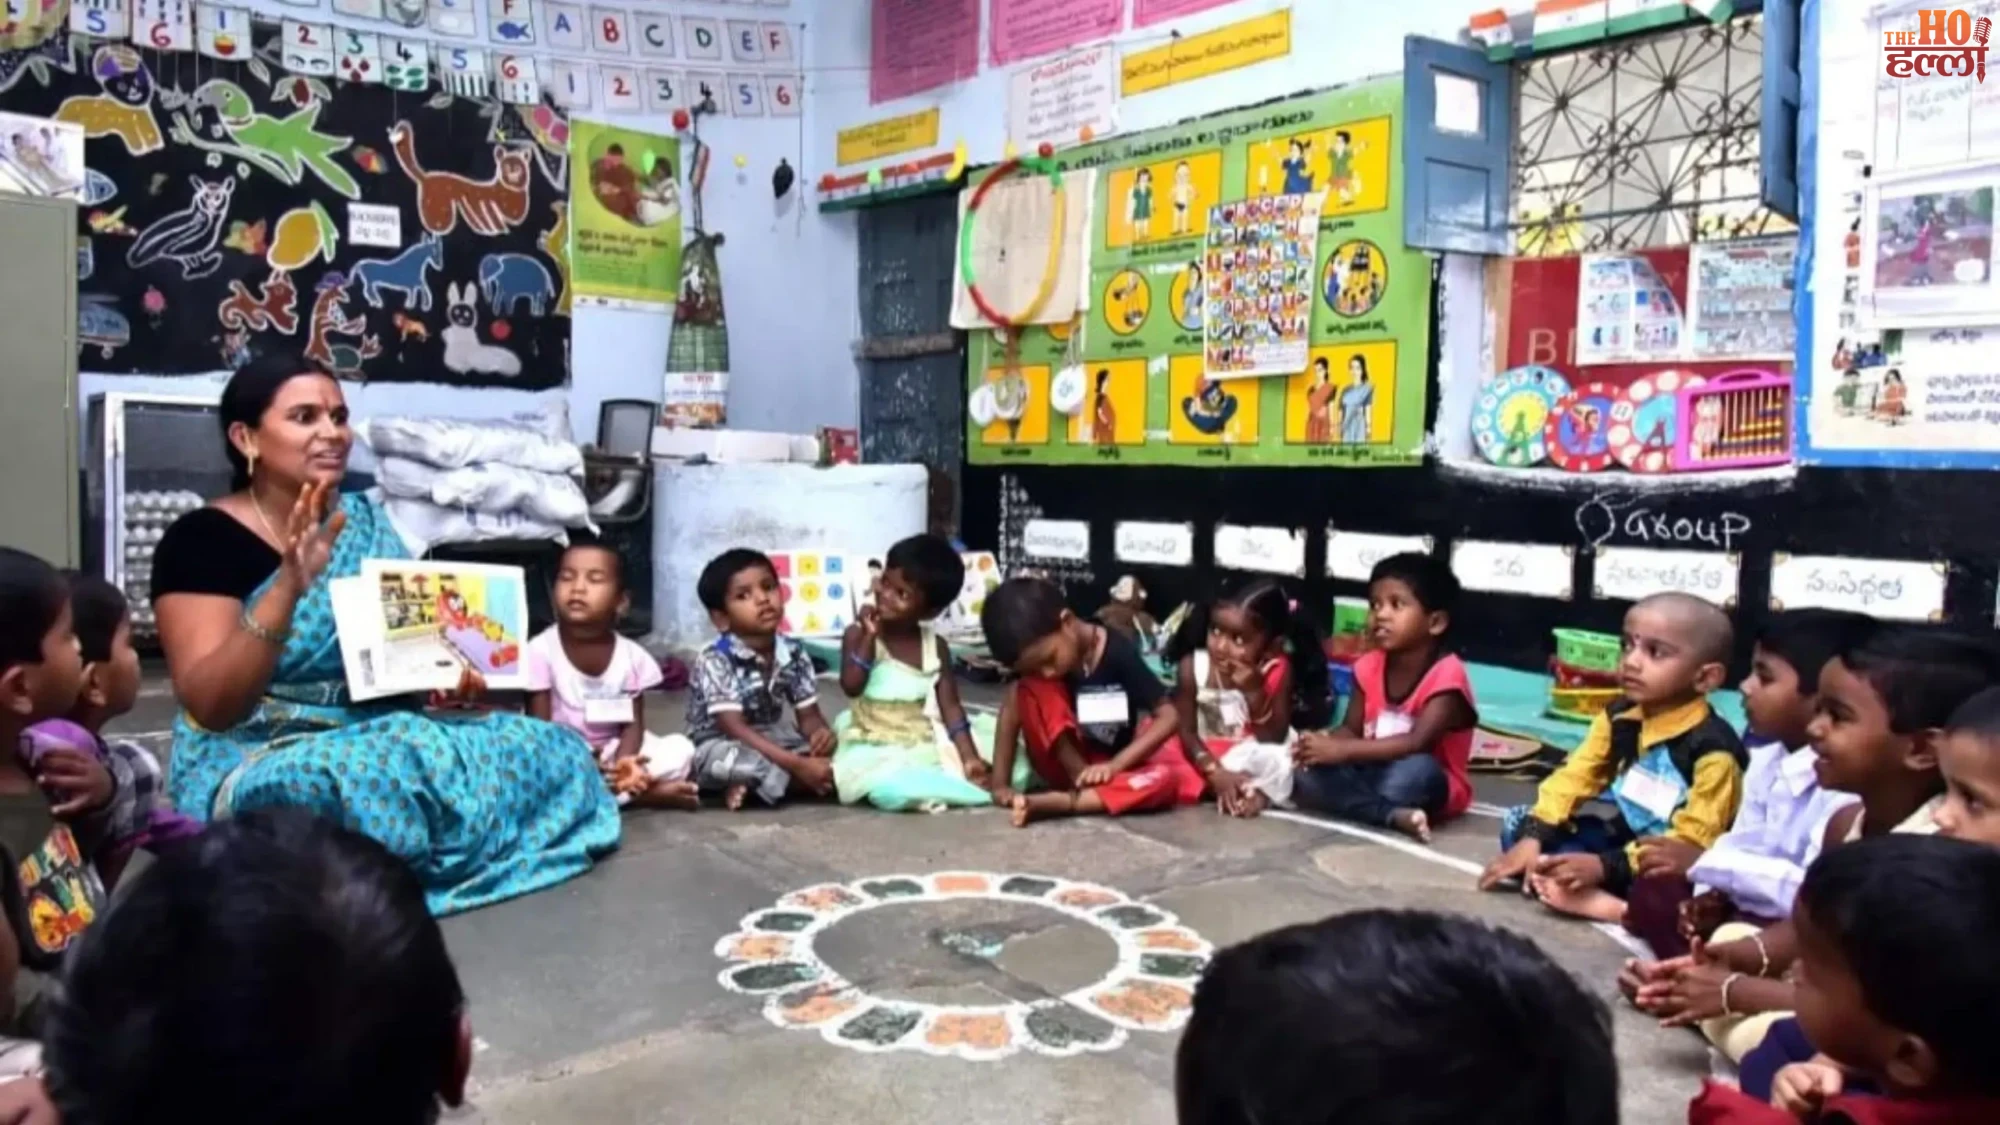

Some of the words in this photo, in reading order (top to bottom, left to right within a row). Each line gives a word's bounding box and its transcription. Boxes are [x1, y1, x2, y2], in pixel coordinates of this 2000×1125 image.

[150, 22, 172, 48] 6
[219, 9, 226, 30] 1
[297, 24, 319, 45] 2
[346, 29, 364, 54] 3
[396, 41, 413, 63] 4
[452, 49, 468, 70] 5
[501, 55, 519, 80] 6
[553, 13, 572, 33] A
[602, 18, 619, 43] B
[644, 23, 664, 48] C
[694, 27, 713, 48] D
[741, 30, 754, 52] E
[769, 31, 781, 50] F
[567, 72, 575, 94] 1
[612, 77, 631, 97] 2
[656, 78, 673, 100] 3
[738, 84, 753, 105] 5
[775, 84, 791, 106] 6
